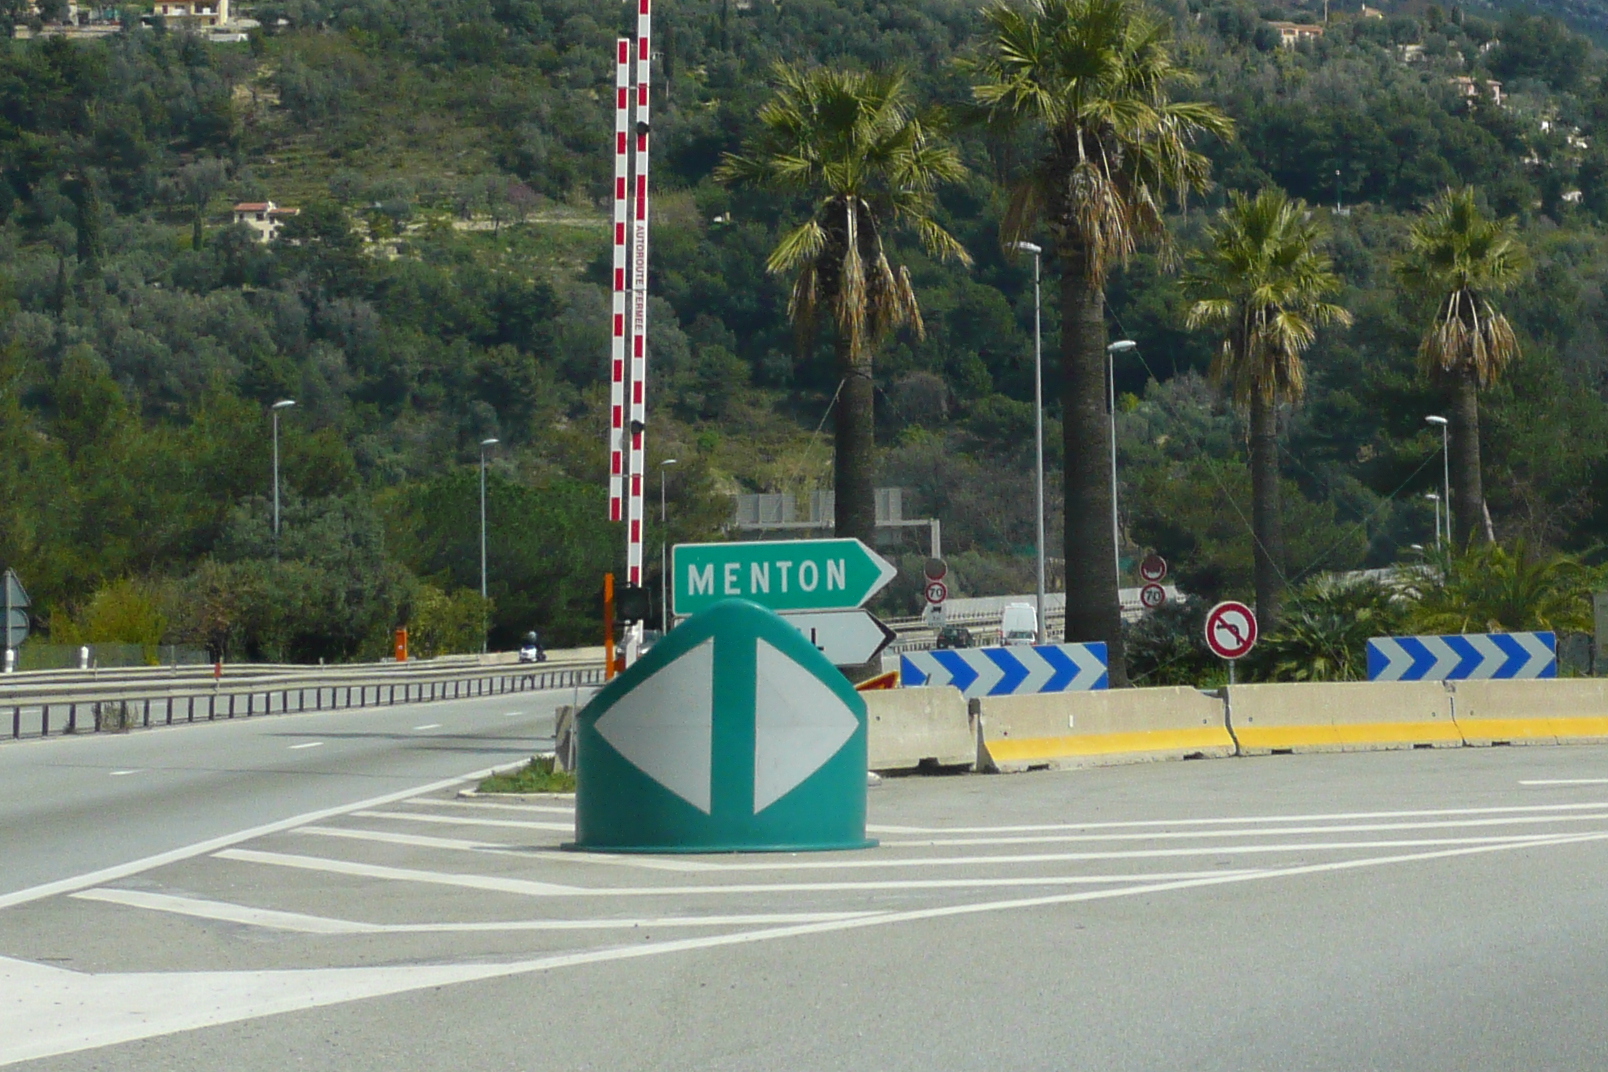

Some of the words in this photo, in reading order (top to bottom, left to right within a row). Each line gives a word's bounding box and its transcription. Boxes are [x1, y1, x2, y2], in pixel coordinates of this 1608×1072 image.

[635, 225, 645, 285] AUTOROUTE
[687, 558, 846, 596] MENTON
[928, 587, 943, 598] 70
[1146, 589, 1161, 602] 70
